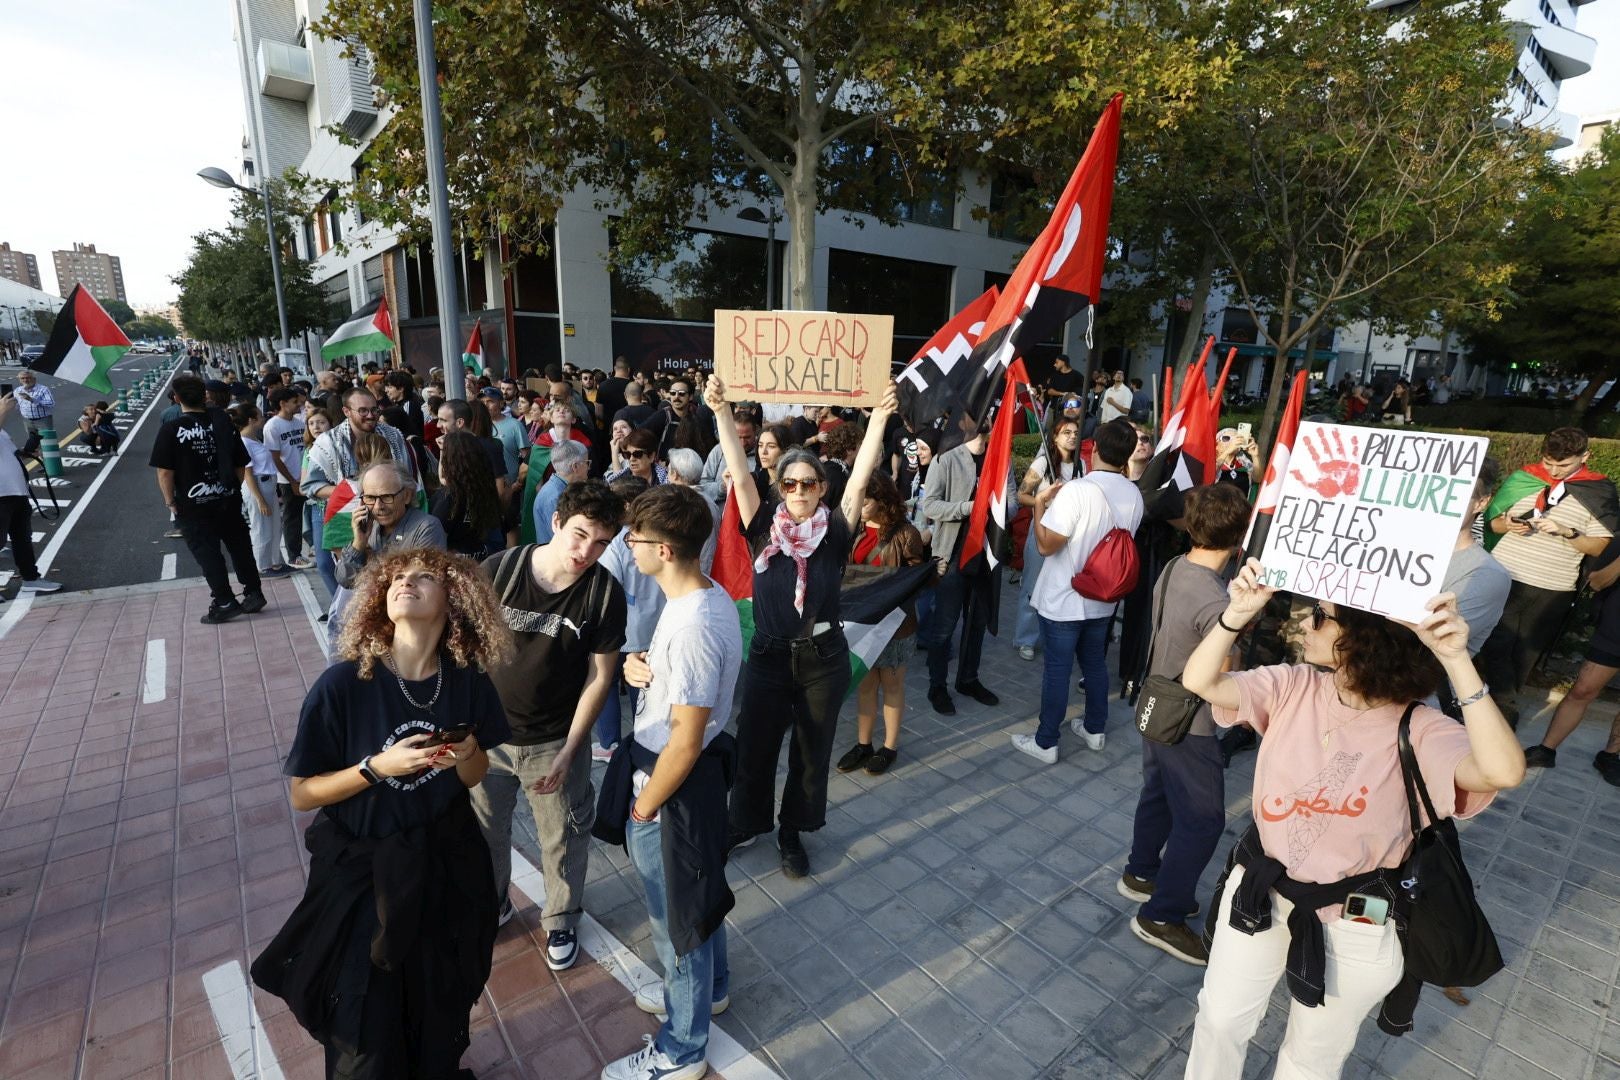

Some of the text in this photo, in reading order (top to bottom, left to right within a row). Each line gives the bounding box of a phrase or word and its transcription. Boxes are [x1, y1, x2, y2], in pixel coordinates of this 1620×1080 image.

[733, 315, 869, 360] RED CARD
[754, 356, 852, 392] ISRAEL
[1331, 503, 1383, 543] LES
[1292, 560, 1390, 615] ISRAEL
[1140, 696, 1156, 731] adidas
[385, 776, 402, 789] REE
[1260, 785, 1369, 822] فلسطين
